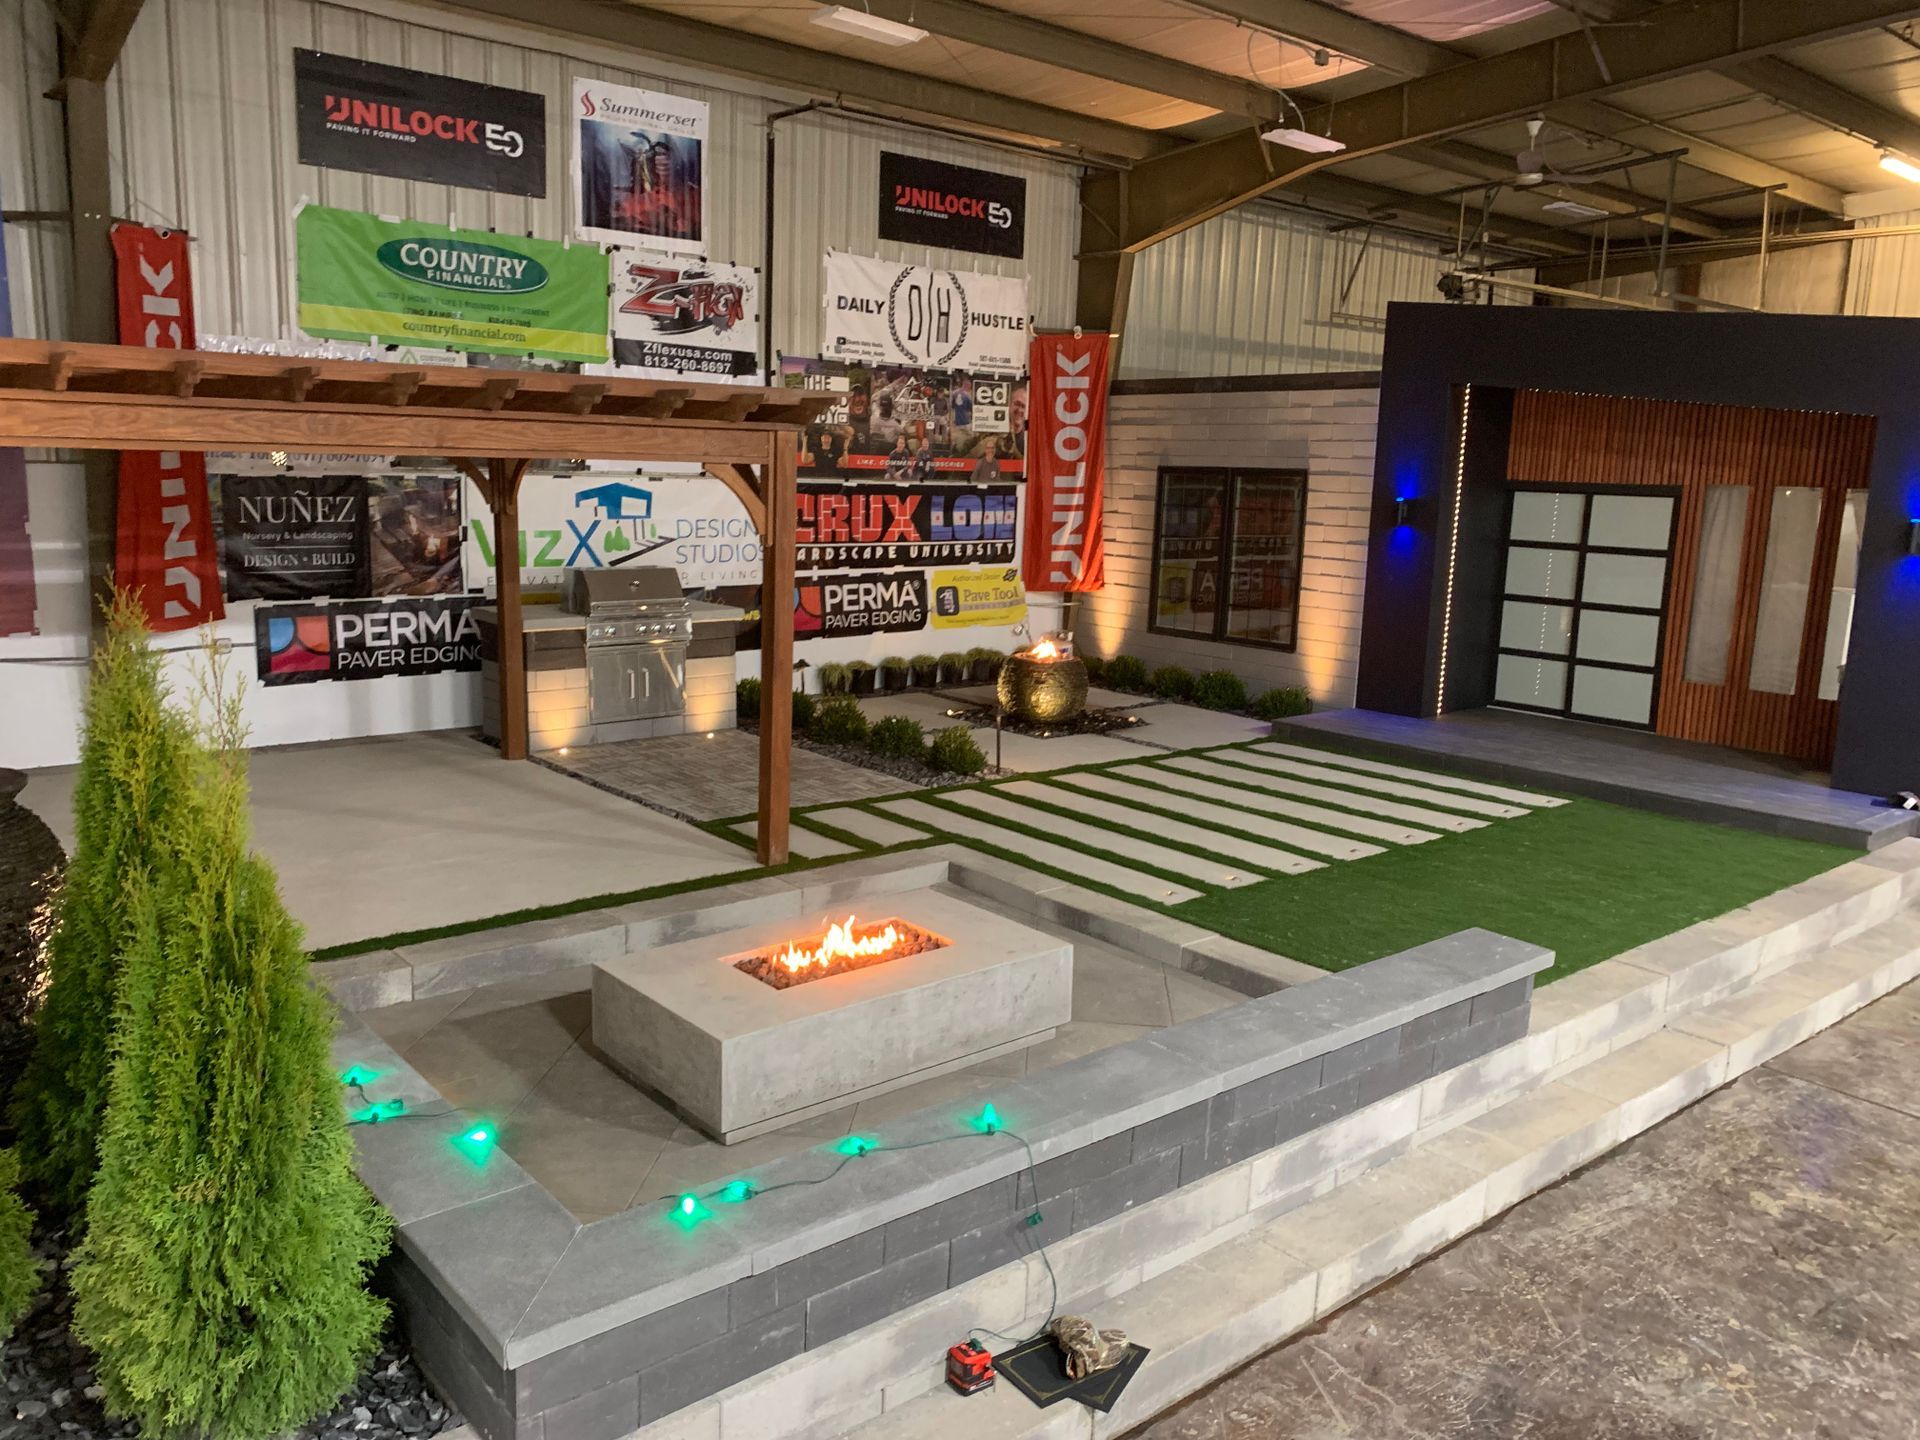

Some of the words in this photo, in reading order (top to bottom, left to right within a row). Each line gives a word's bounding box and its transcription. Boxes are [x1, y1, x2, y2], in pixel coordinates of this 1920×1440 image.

[325, 95, 480, 144] UNILOCK
[600, 97, 697, 127] Summerset
[326, 122, 360, 134] PAVING
[361, 127, 371, 136] IT
[372, 129, 417, 143] FORWARD
[895, 185, 986, 219] UNILOCK
[400, 242, 529, 280] COUNTRY
[836, 295, 885, 315] DAILY
[402, 320, 527, 343] countryfinancial.com
[971, 312, 1024, 331] HUSTLE
[643, 342, 733, 362] Zflexusa.com
[1050, 350, 1091, 584] UNILOCK
[238, 489, 356, 524] NUÑEZ
[795, 494, 922, 543] CRUX
[243, 554, 299, 568] DESIGN
[312, 552, 356, 566] BUILD
[797, 546, 897, 561] ARDSCAPE
[909, 543, 1015, 559] UNIVERSITY
[700, 570, 758, 581] LIVING
[963, 588, 991, 602] Pave
[992, 586, 1019, 601] Tool
[335, 608, 481, 649] PERMA
[825, 611, 869, 629] PAVER
[871, 608, 922, 626] EDGING
[338, 650, 405, 669] PAVER
